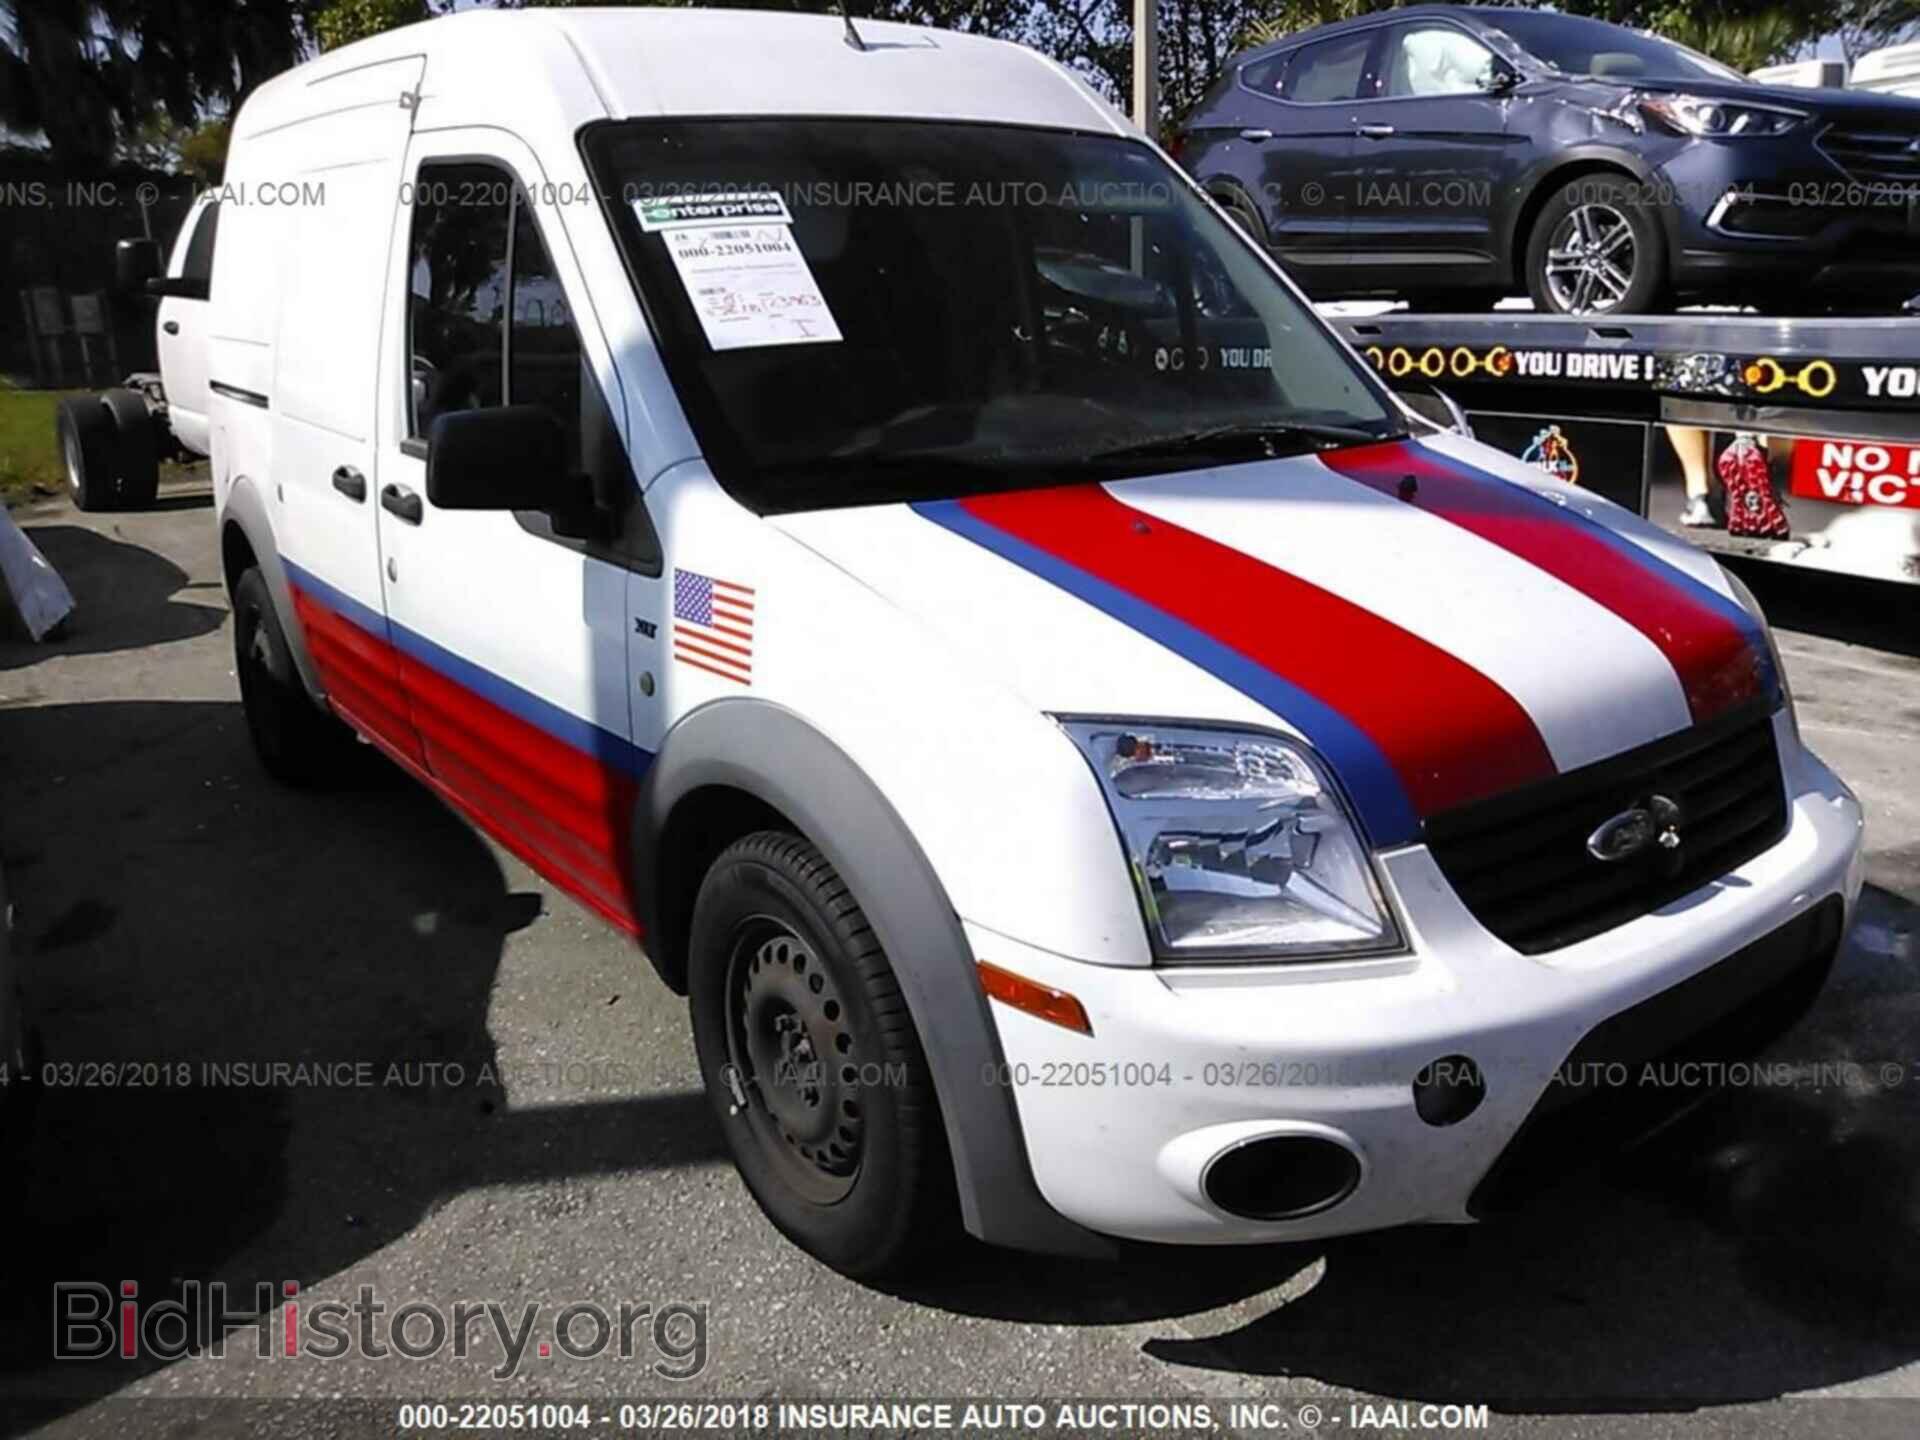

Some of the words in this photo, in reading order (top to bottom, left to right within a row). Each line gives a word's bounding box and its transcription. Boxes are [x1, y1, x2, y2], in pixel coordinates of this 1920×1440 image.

[650, 201, 781, 220] enterprise
[678, 241, 792, 259] 000-22051004
[1220, 347, 1249, 367] YOU
[1515, 351, 1561, 376] YOU
[1566, 354, 1639, 380] DRIVE
[1862, 367, 1920, 397] YO
[1822, 443, 1891, 472] NO
